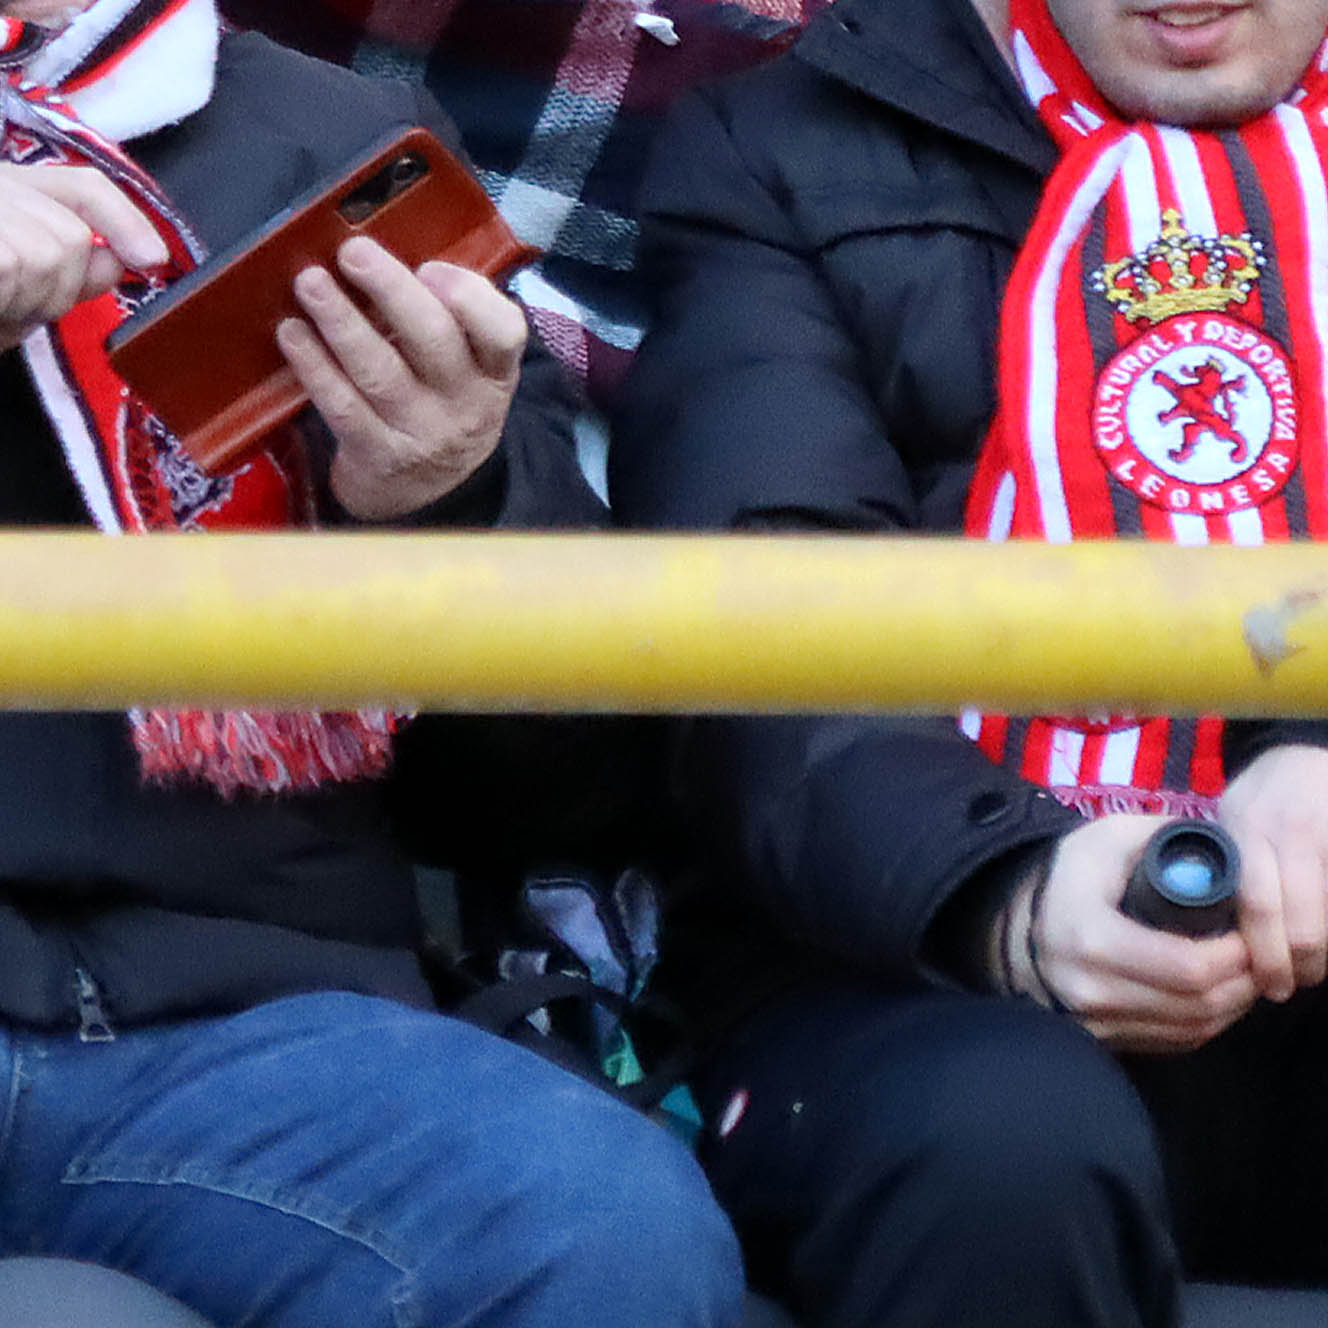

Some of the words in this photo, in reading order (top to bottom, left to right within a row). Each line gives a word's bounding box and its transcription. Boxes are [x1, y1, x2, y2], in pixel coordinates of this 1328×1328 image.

[1096, 334, 1173, 449] CULTURAL
[1174, 321, 1198, 342] Y
[1203, 321, 1297, 440] DEPORTIVA
[1114, 452, 1290, 510] LEONESA
